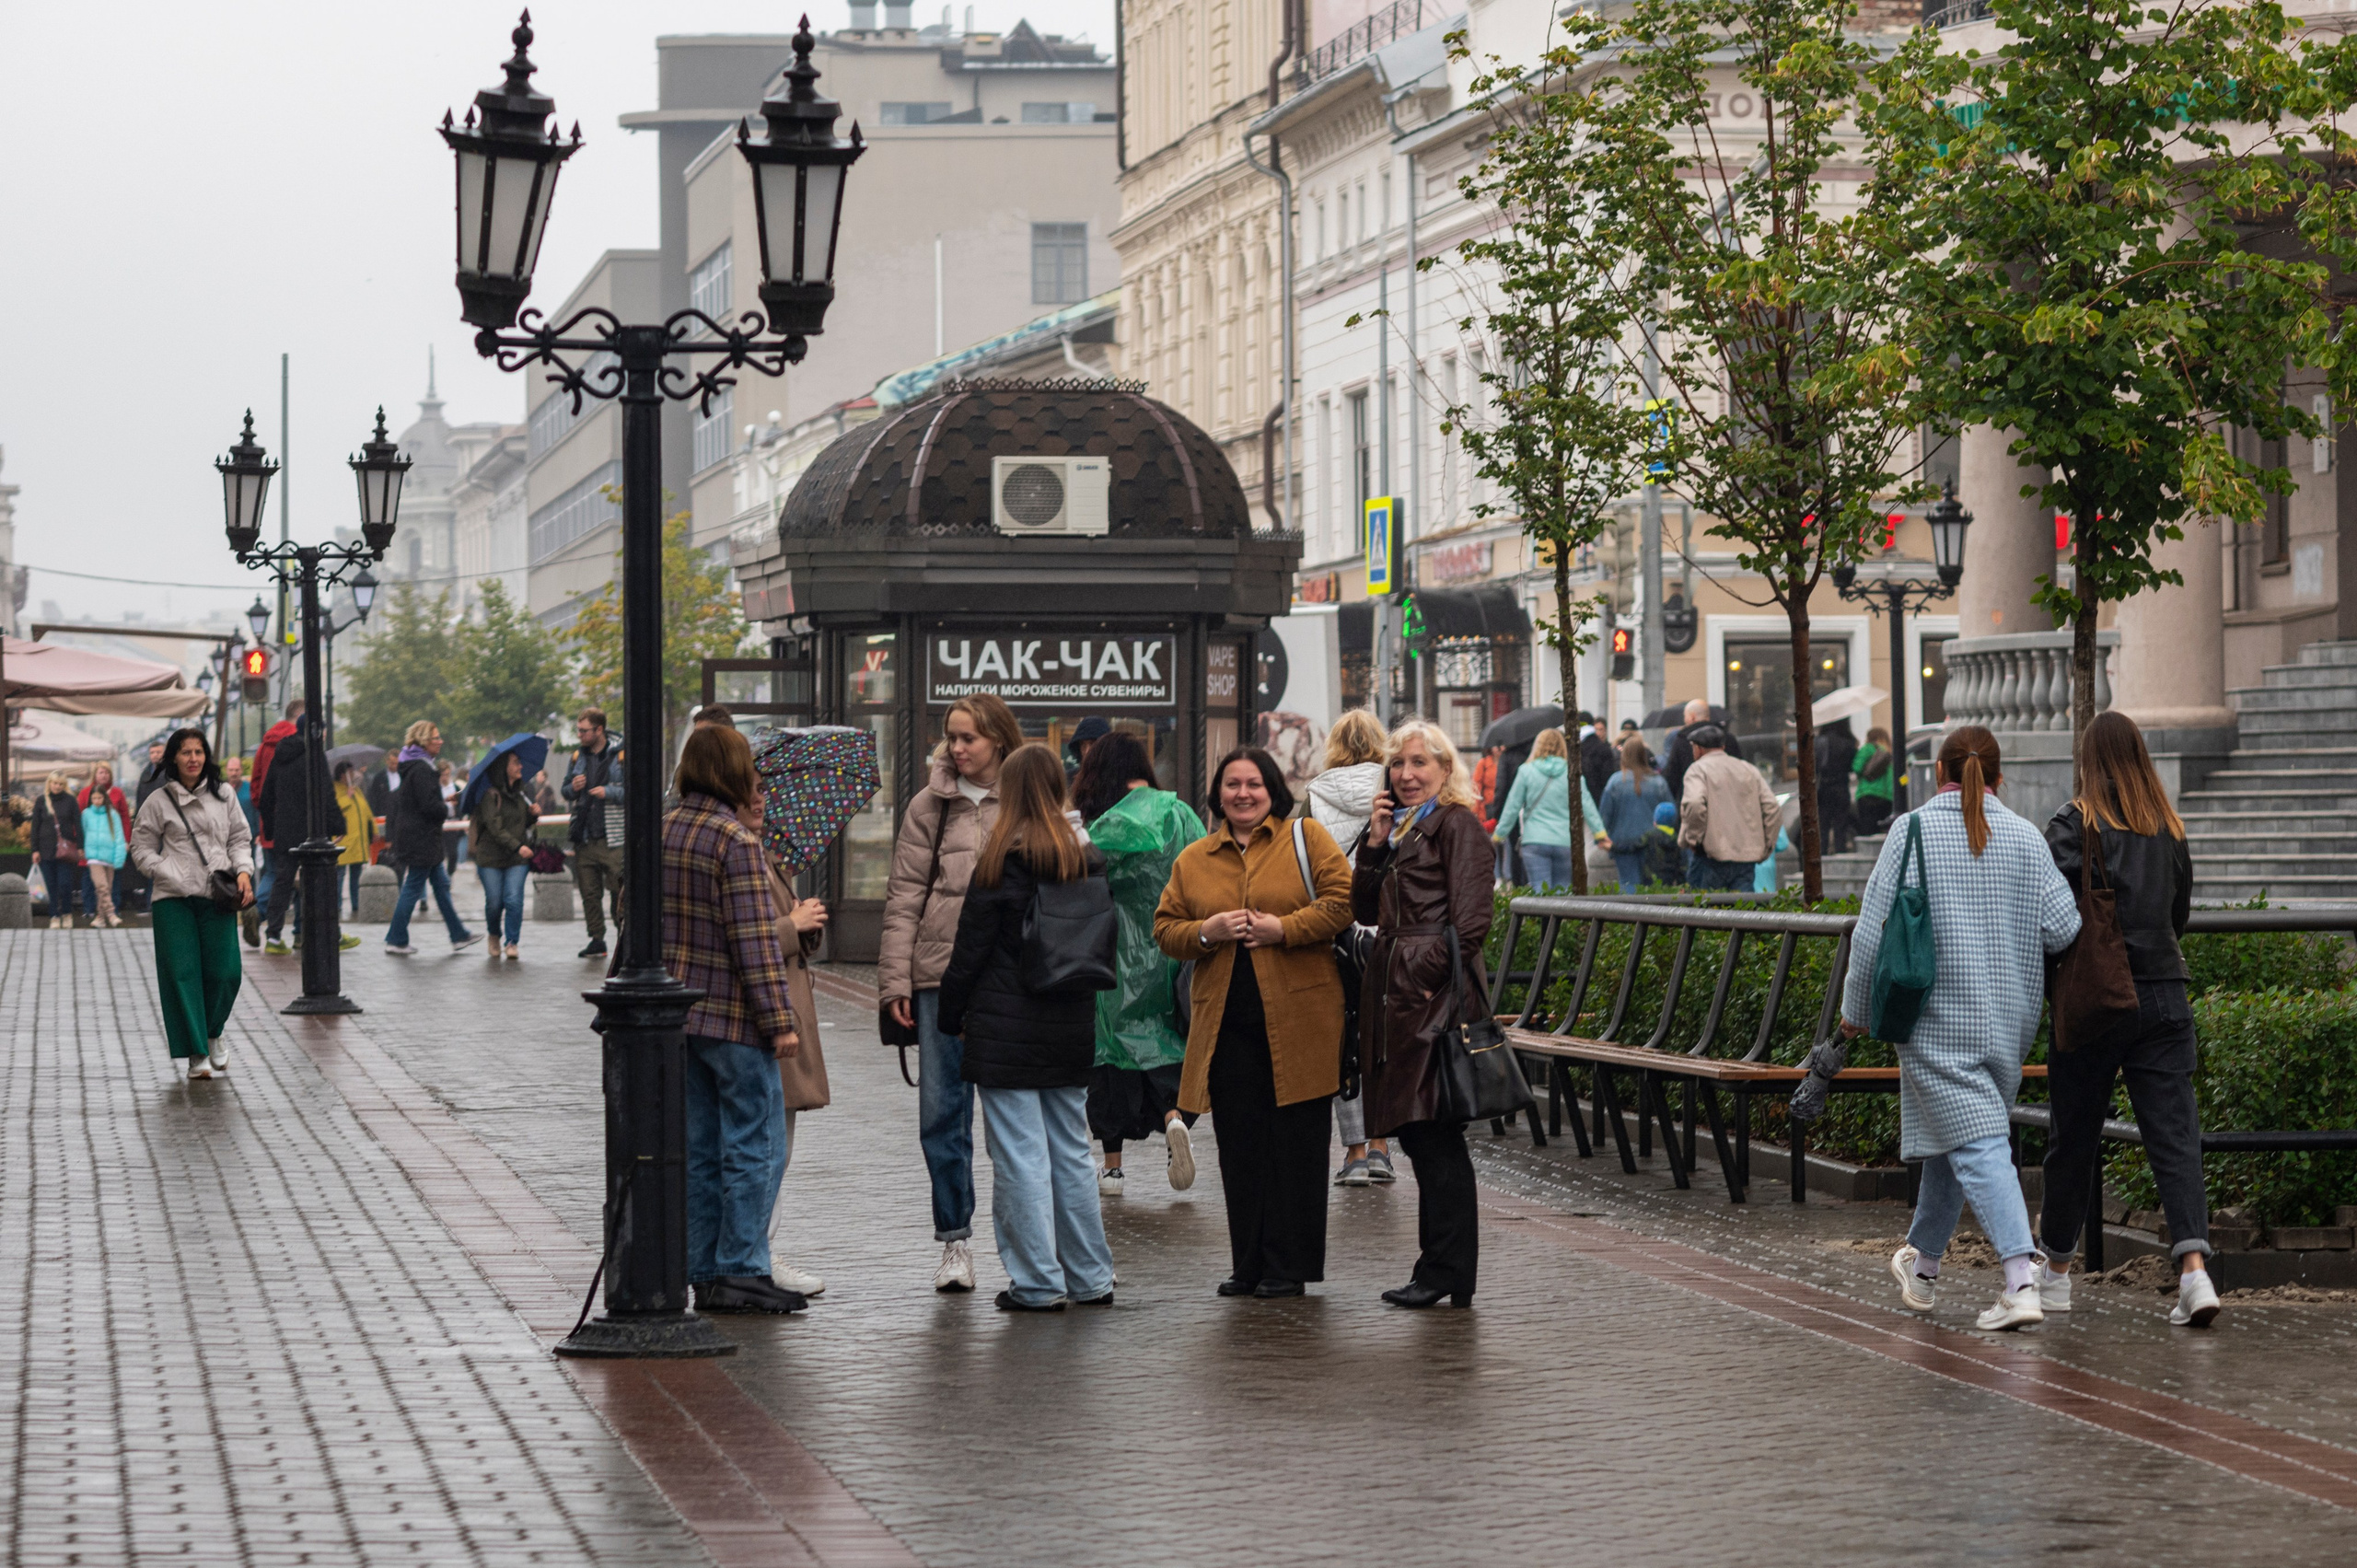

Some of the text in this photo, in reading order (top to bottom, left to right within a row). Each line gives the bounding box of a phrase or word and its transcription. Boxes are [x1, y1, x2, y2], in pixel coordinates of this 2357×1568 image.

[938, 640, 1162, 680] ЧАК-ЧАК
[1208, 645, 1236, 668] VAPE
[935, 684, 1166, 697] НАПИТКИ МОРОЖЕНОЕ СУВЕНИРЫ
[1207, 674, 1236, 696] SHOP
